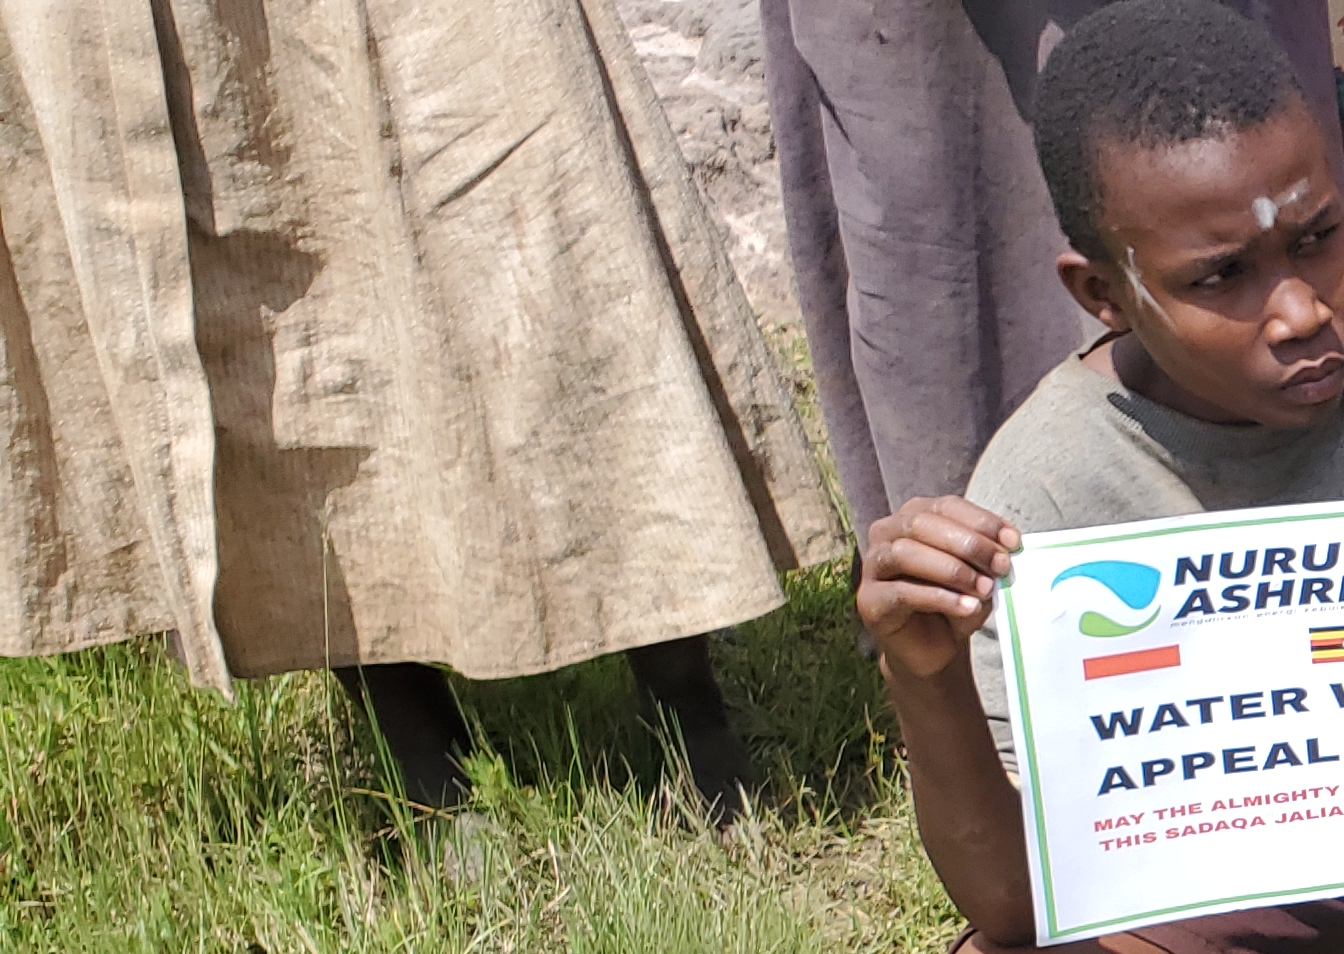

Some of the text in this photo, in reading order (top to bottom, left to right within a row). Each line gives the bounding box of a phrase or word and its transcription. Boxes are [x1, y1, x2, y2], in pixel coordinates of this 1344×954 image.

[1089, 687, 1310, 741] WATER
[1097, 737, 1340, 797] APPEAL
[1093, 814, 1144, 833] MAY
[1153, 803, 1203, 821] THE
[1210, 785, 1340, 813] ALMIGHTY
[1099, 831, 1158, 852] THIS
[1165, 815, 1266, 841] SADAQA
